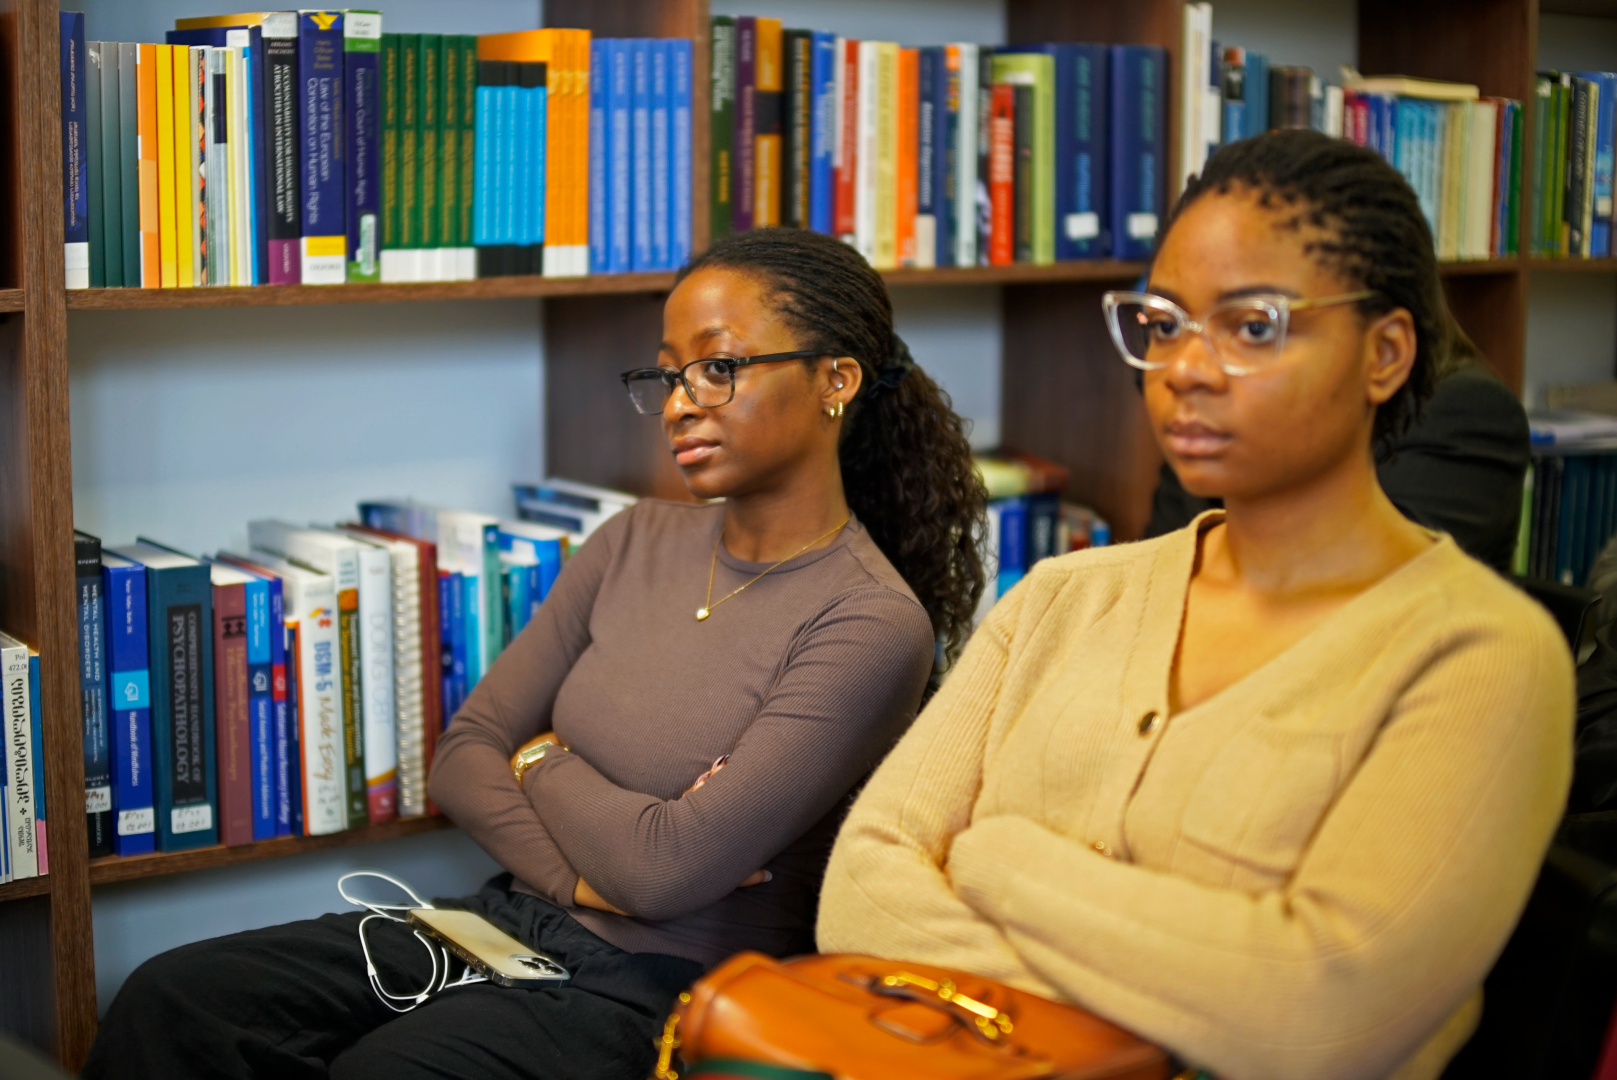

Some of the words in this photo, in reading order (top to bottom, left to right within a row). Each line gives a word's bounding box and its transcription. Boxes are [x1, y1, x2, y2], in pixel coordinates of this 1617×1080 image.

[274, 64, 283, 114] ATROCITIES
[282, 64, 293, 136] ACCOUNTABILITY
[320, 77, 331, 98] Law
[355, 68, 366, 107] European
[308, 77, 319, 135] Convention
[320, 101, 331, 112] of
[320, 114, 331, 130] the
[356, 108, 366, 134] Court
[275, 126, 285, 194] INTERNATIONAL
[284, 137, 293, 155] FOR
[308, 137, 317, 151] on
[319, 132, 332, 181] European
[285, 156, 294, 189] HUMAN
[309, 152, 319, 189] Human
[357, 147, 367, 178] Human
[276, 195, 285, 214] LAW
[286, 190, 295, 223] RIGHTS
[306, 191, 320, 224] Rights
[355, 179, 367, 205] Rights
[188, 611, 200, 700] COMPREHENSIVE
[369, 612, 388, 681] DOING
[314, 641, 334, 692] DSM-5
[173, 614, 189, 783] PSYCHOPATHOLOGY
[372, 684, 391, 726] CBT
[130, 711, 138, 742] Handbook
[190, 704, 201, 765] HANDBOOK
[278, 702, 287, 739] Substance
[319, 696, 335, 740] Made
[11, 678, 30, 804] პოლიტოლოგია
[279, 740, 288, 759] Abuse
[131, 751, 140, 787] Mindfulness
[191, 768, 201, 783] OF
[278, 760, 289, 791] Recovery
[313, 742, 336, 782] Easy
[280, 799, 291, 824] College
